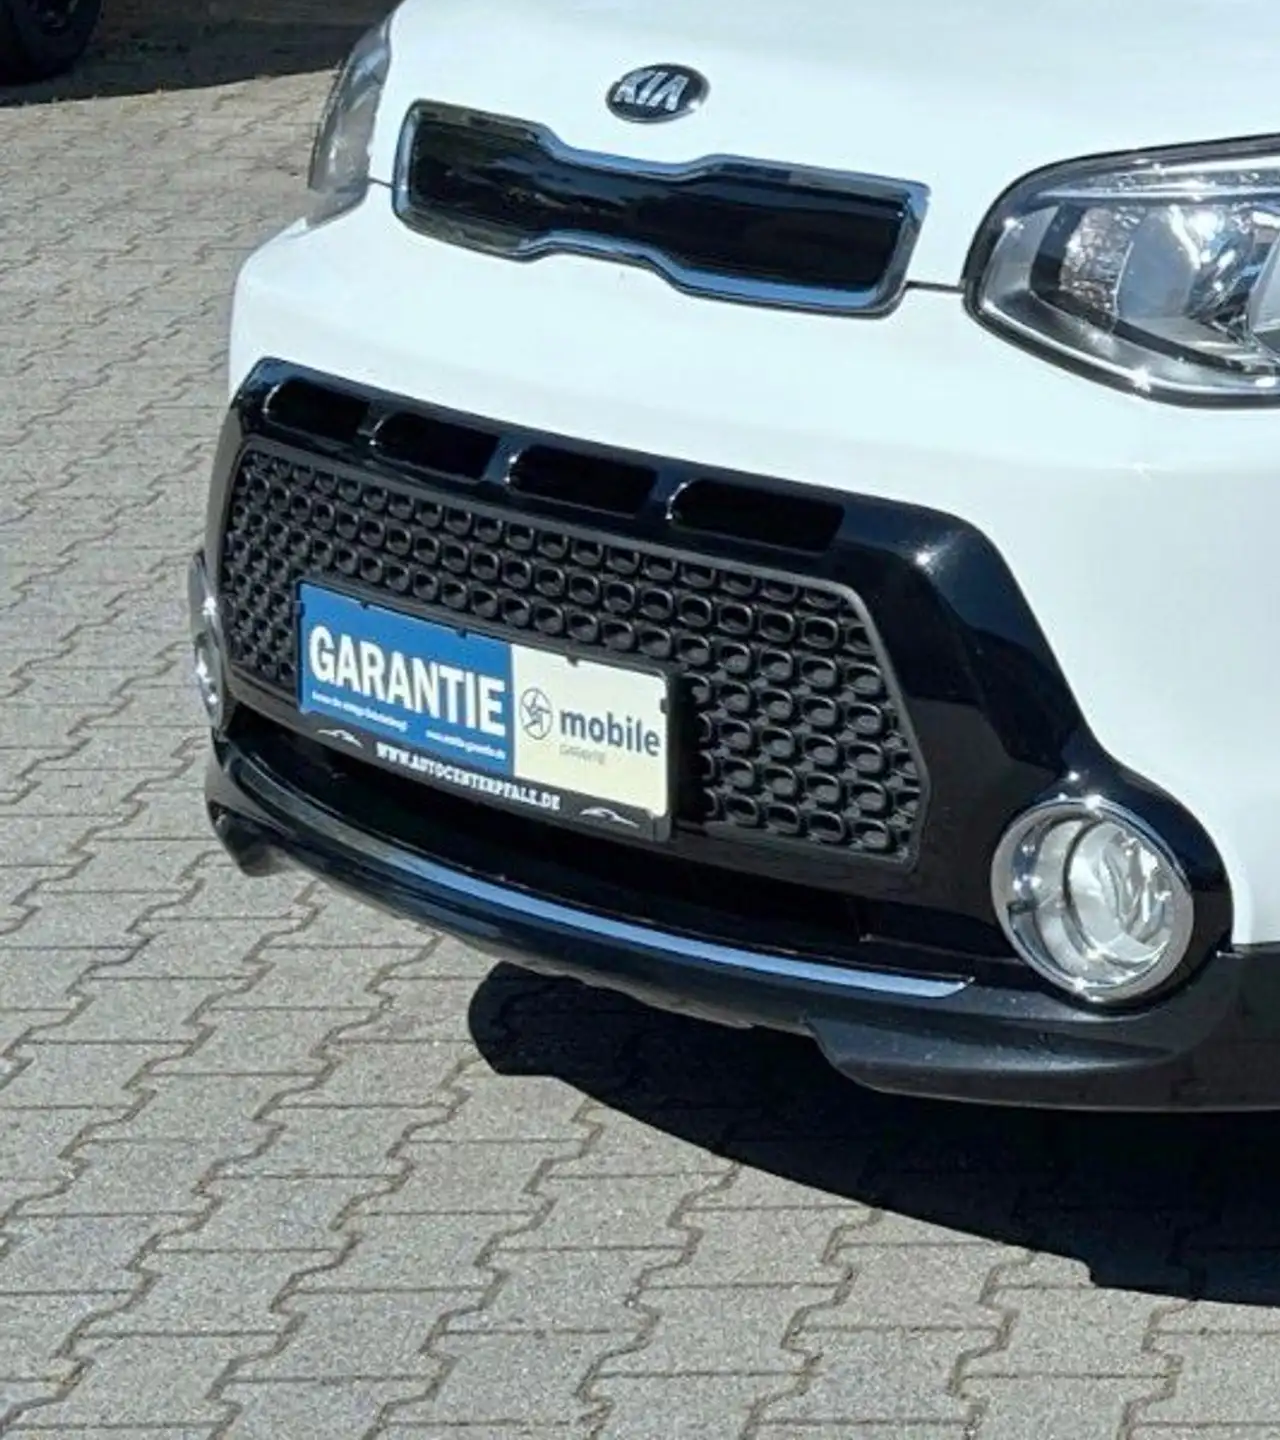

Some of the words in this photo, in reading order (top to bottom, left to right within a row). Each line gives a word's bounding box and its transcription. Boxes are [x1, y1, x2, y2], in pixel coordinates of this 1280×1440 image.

[612, 70, 689, 112] KIA
[308, 625, 507, 736] GARANTIE
[559, 710, 661, 757] mobile
